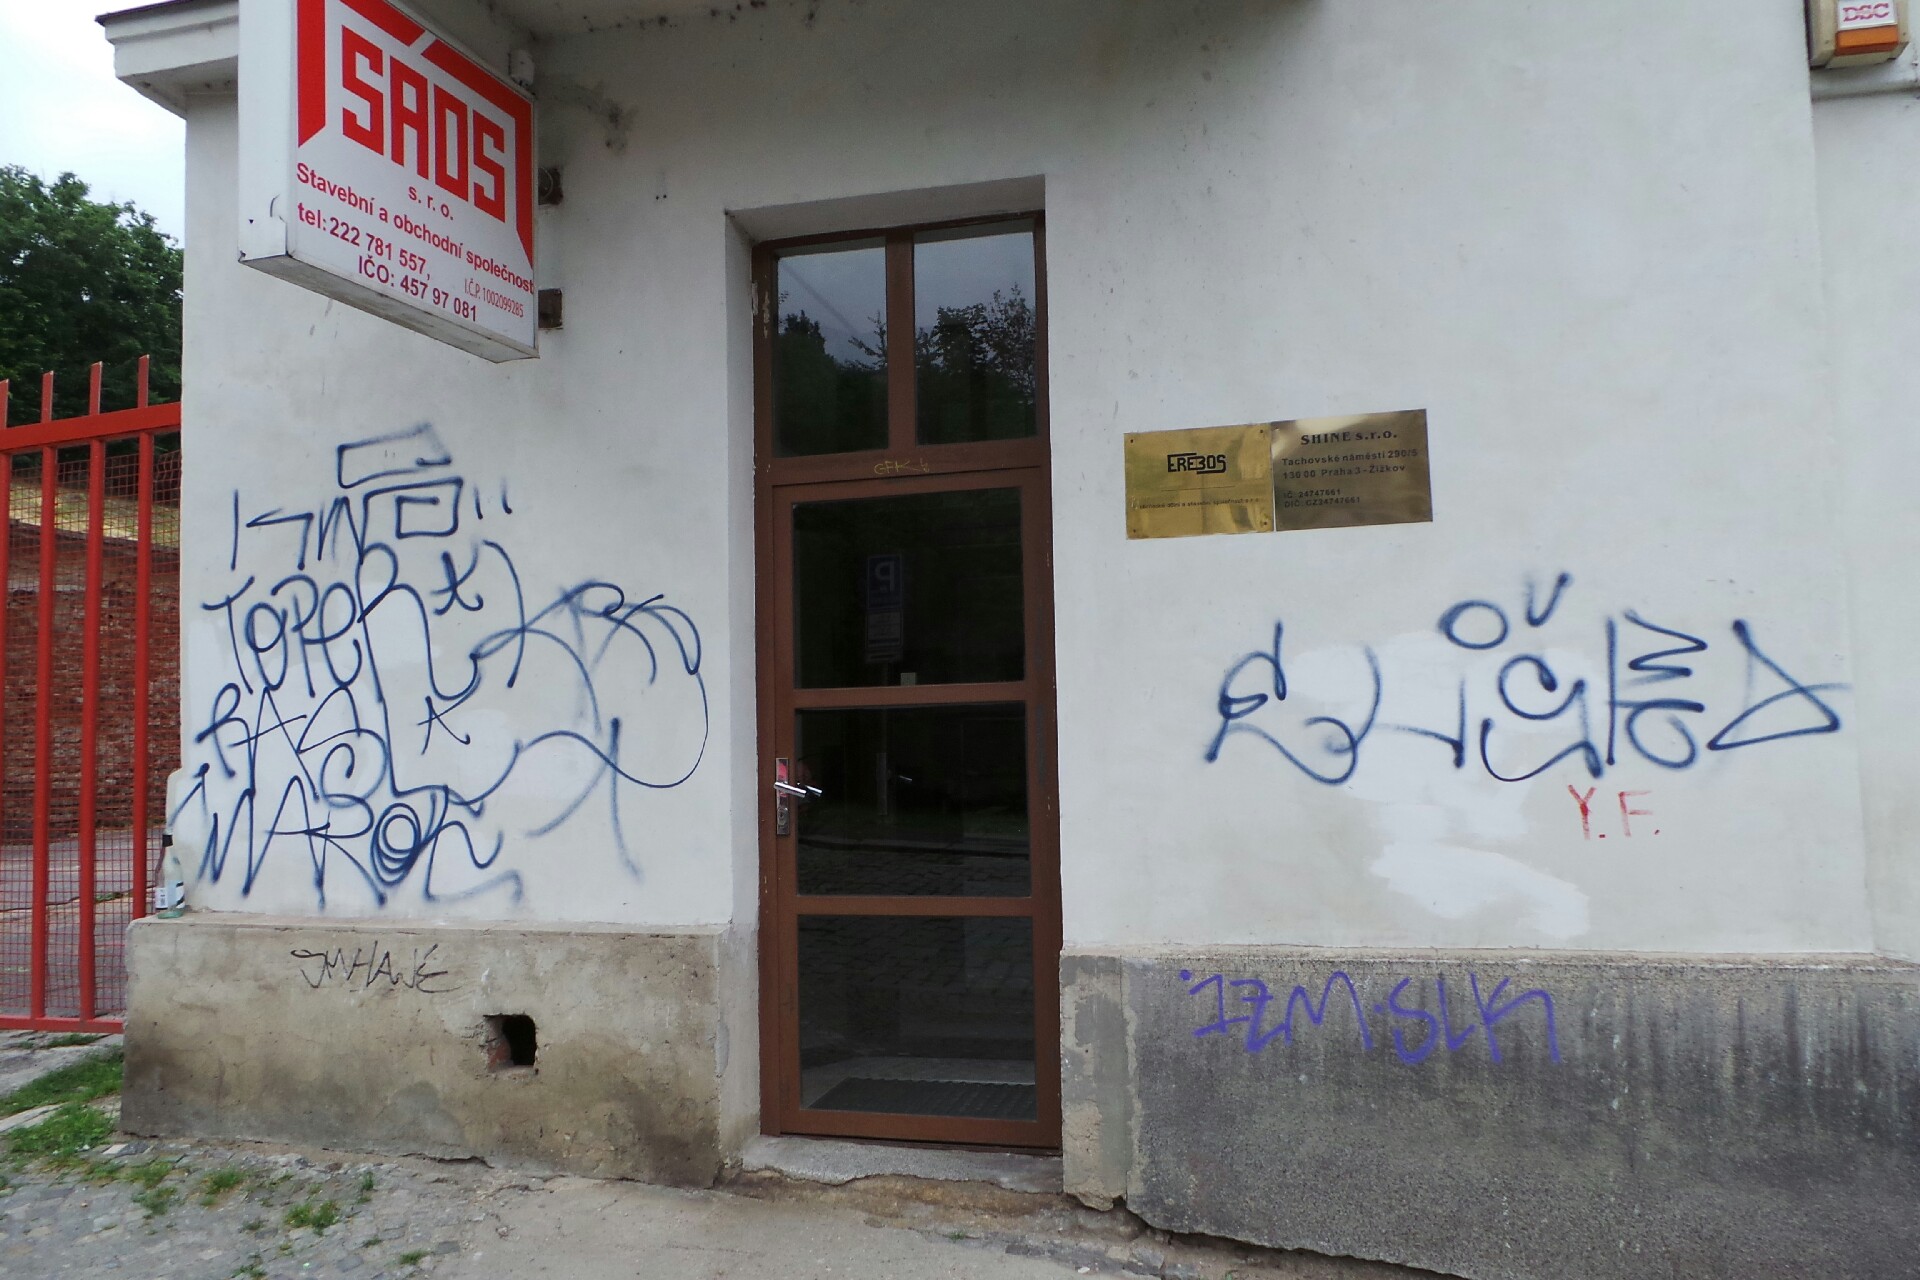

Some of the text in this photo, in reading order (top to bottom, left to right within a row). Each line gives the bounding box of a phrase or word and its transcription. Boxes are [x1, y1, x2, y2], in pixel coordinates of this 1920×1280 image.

[296, 162, 534, 295] Stavební a obchodní společnost
[366, 233, 392, 260] 781
[358, 254, 477, 322] IČO: 457 97 081
[1301, 430, 1398, 445] SHINE s.r.o.
[1282, 454, 1340, 466] Tachovské
